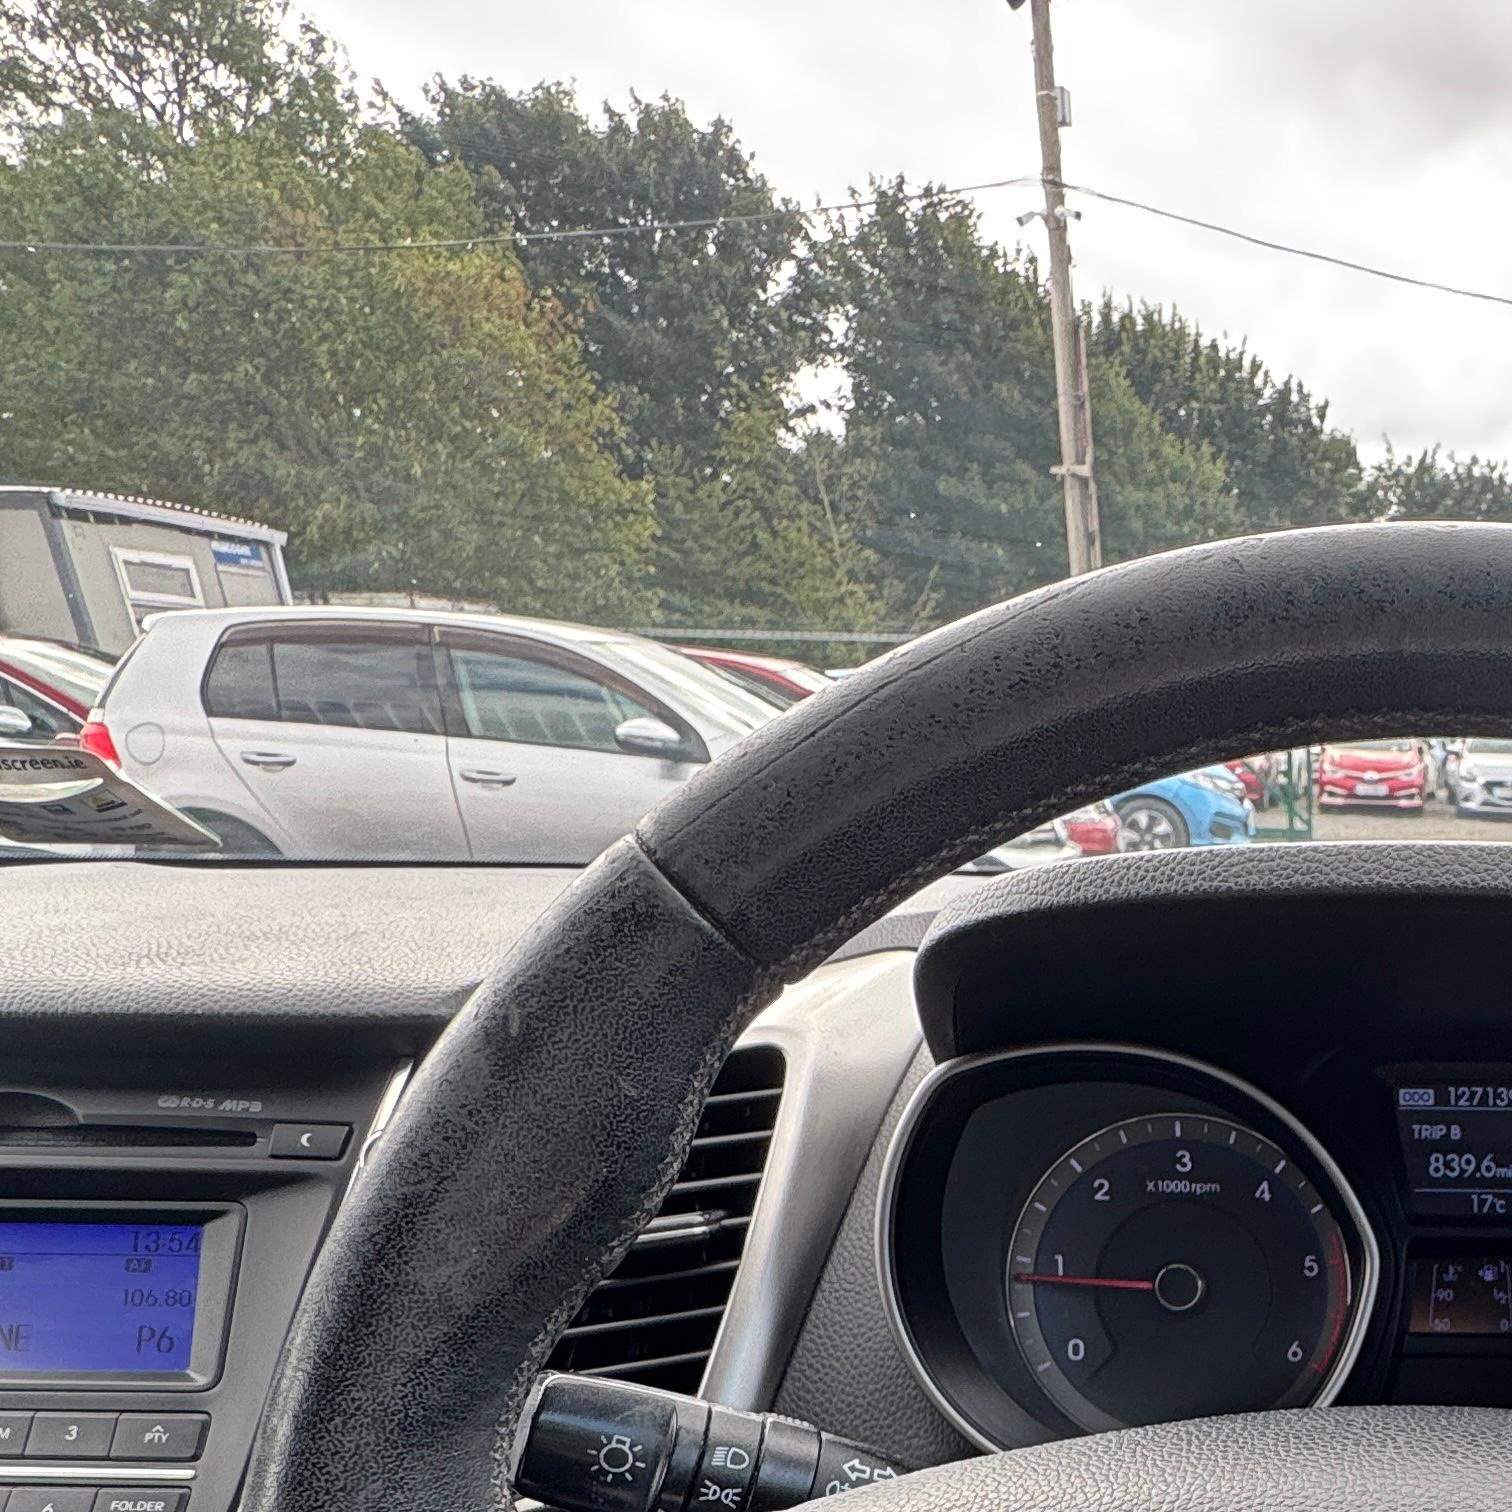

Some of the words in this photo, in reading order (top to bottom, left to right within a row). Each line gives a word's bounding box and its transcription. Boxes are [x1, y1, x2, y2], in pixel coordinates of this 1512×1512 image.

[0, 755, 87, 771] screen.ie
[218, 1099, 262, 1112] MP3
[1412, 1124, 1447, 1140] TRIP
[1450, 1124, 1462, 1140] B
[1175, 1150, 1193, 1172] 3
[1428, 1153, 1497, 1178] 839.6
[1093, 1178, 1111, 1201] 2
[1254, 1180, 1272, 1203] 4
[131, 1230, 202, 1253] 13:54
[1054, 1254, 1064, 1277] 1
[1303, 1254, 1319, 1277] 5
[123, 1288, 192, 1307] 106.80
[136, 1325, 175, 1353] P6
[1067, 1338, 1085, 1361] 0
[1286, 1340, 1303, 1363] 6
[65, 1425, 79, 1441] 3
[144, 1433, 169, 1444] PTY
[110, 1500, 166, 1512] FOLDER
